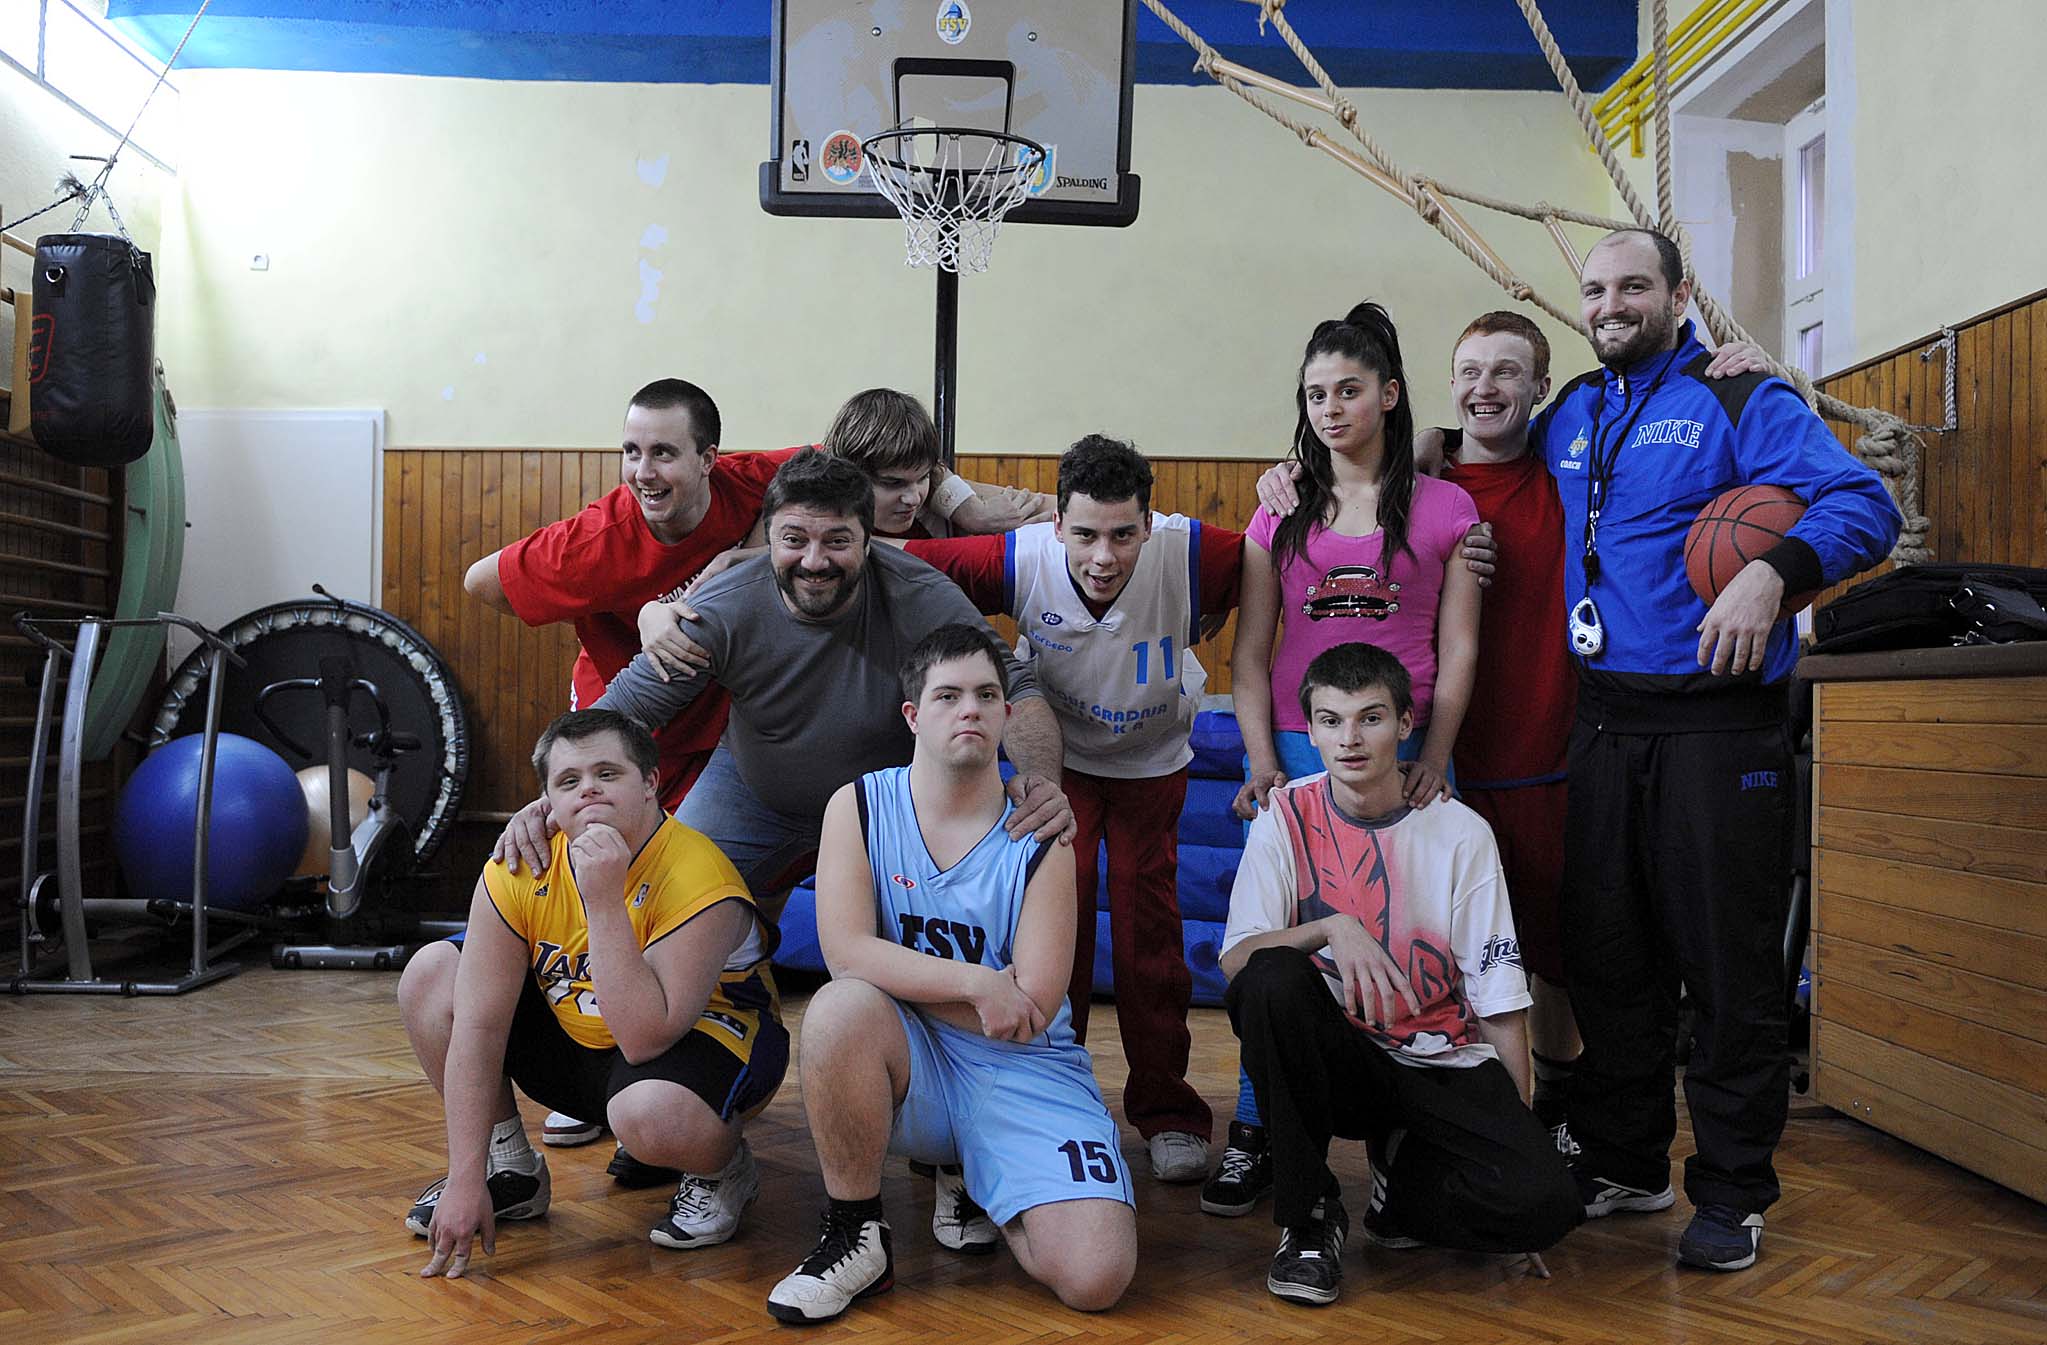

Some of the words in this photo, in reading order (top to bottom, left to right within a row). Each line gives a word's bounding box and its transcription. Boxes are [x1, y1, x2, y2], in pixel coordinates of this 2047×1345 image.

[939, 17, 969, 32] FSV
[1056, 176, 1107, 190] SPALDING
[1632, 419, 1704, 449] NIKE
[1560, 460, 1581, 471] COACH
[1132, 635, 1174, 685] 11
[1740, 771, 1777, 790] NIKE
[899, 913, 986, 965] FSV
[535, 941, 592, 981] LAK
[1057, 1139, 1118, 1184] 15
